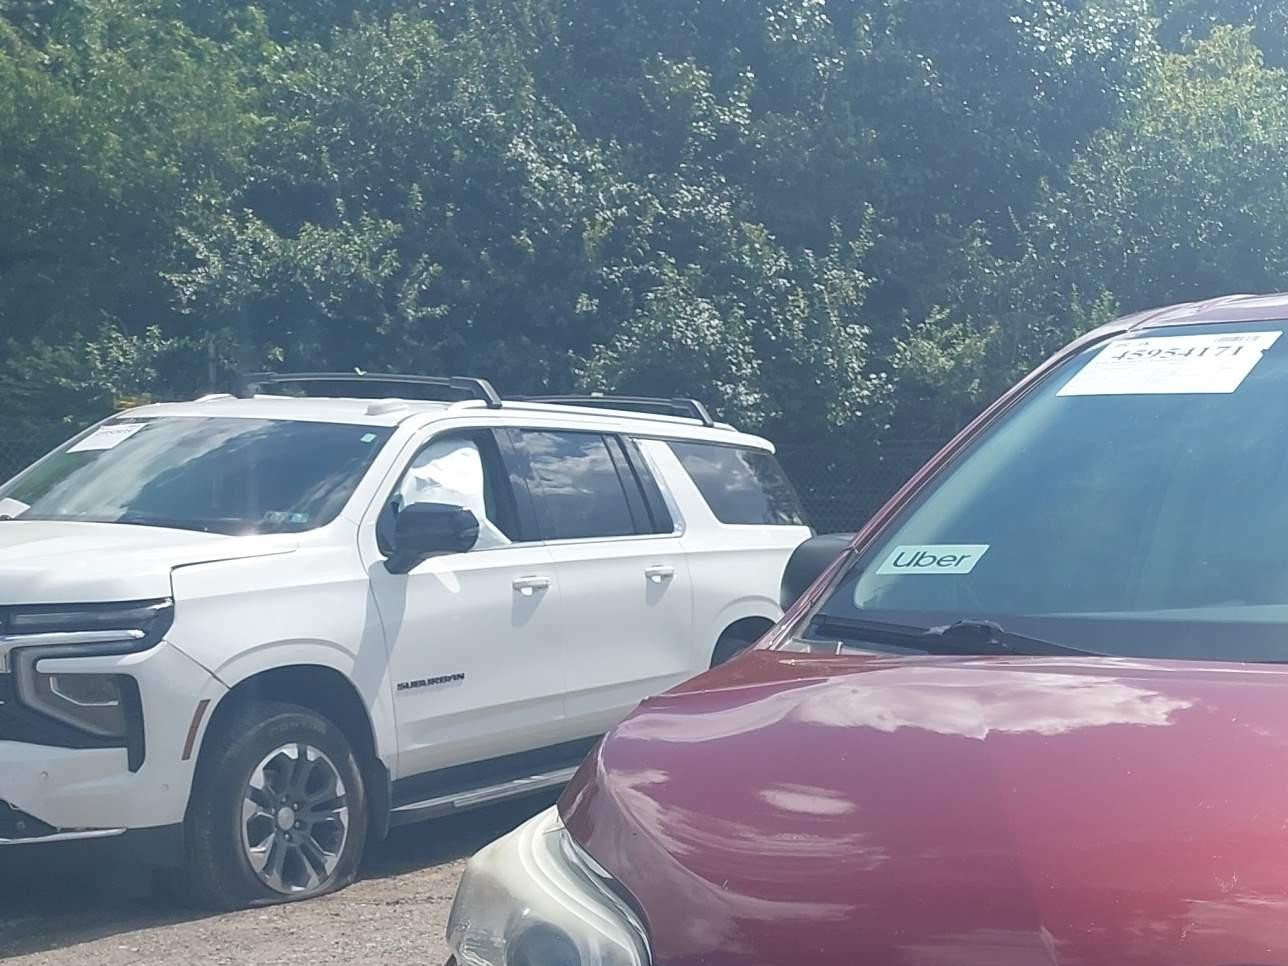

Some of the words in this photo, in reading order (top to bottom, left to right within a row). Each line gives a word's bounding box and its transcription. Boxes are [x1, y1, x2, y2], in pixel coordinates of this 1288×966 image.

[1111, 345, 1245, 361] 45954171
[892, 551, 972, 568] Uber
[397, 673, 465, 690] SUBURBAN
